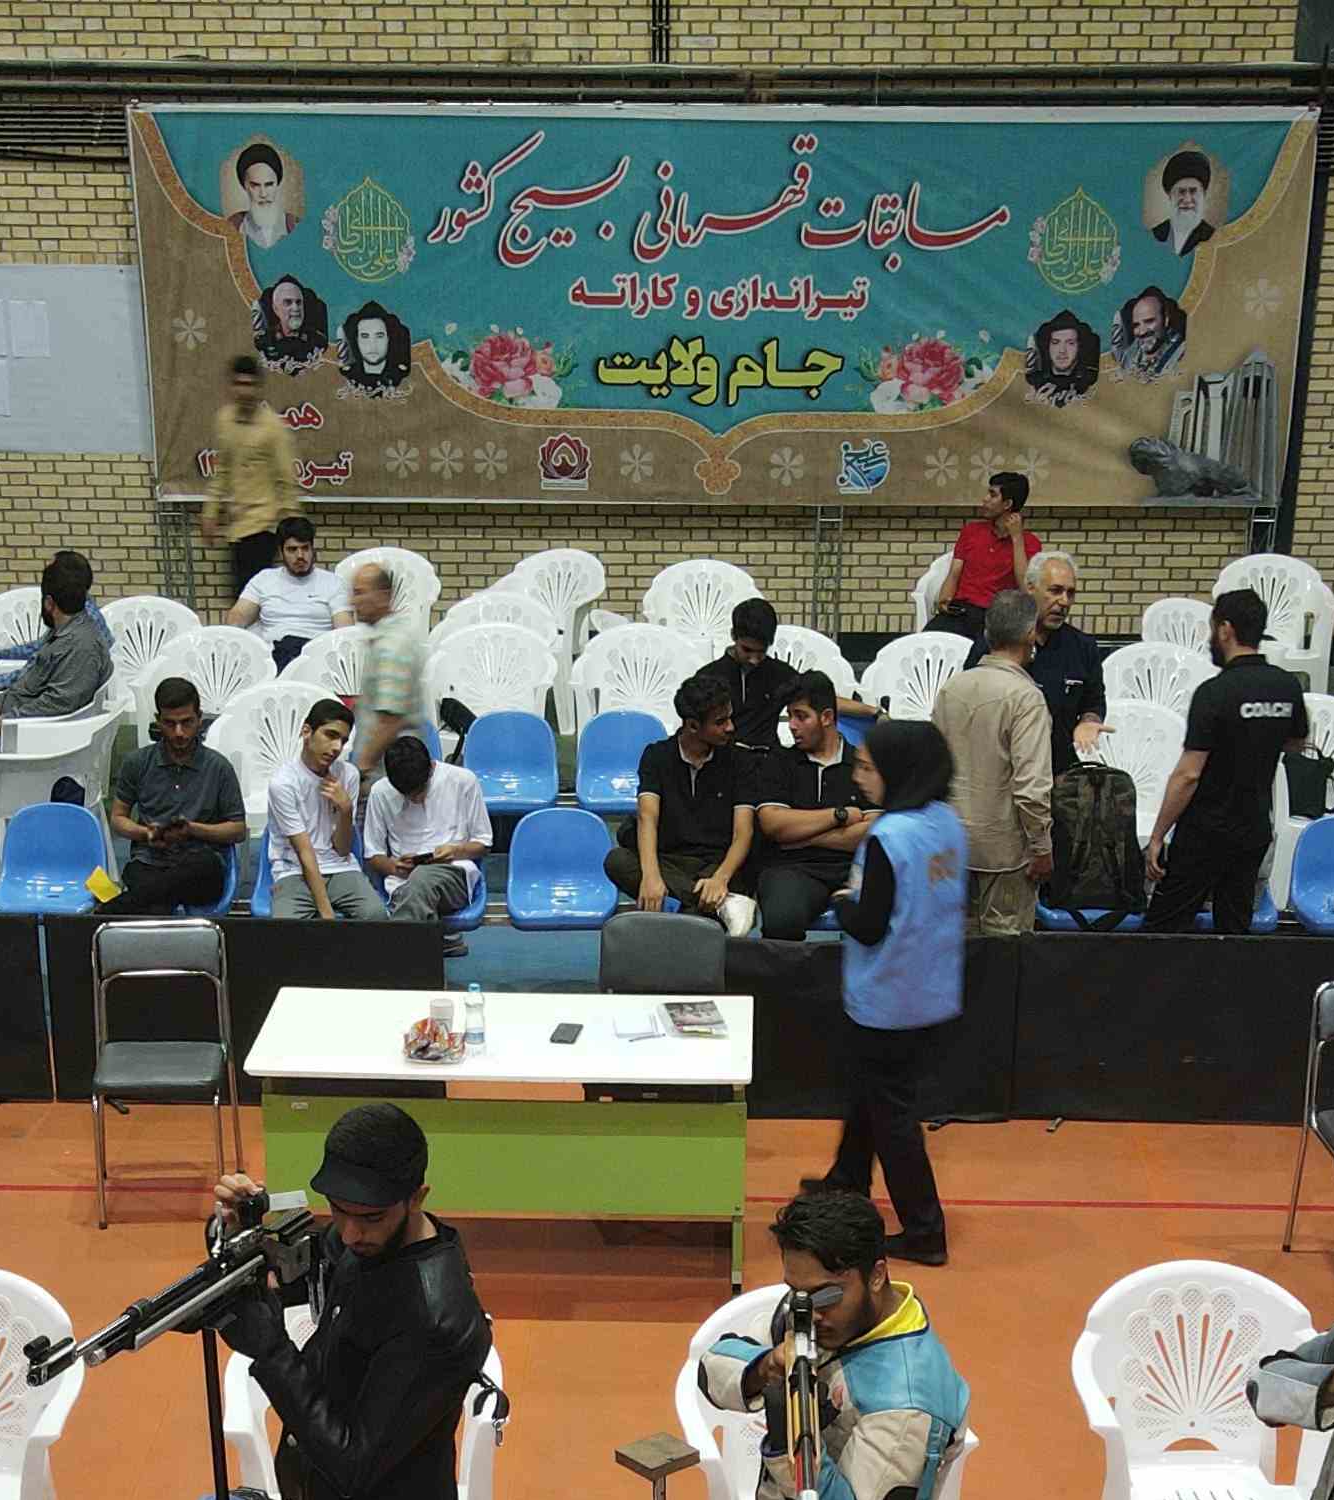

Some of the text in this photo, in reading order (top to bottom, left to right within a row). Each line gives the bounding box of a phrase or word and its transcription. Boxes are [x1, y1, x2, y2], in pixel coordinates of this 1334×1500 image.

[427, 130, 1010, 272] مسابقات قهرمانی بسیج کشور
[570, 273, 870, 320] تیراندازی و کاراته
[596, 335, 845, 406] جام ولایت
[1240, 702, 1292, 718] COACH
